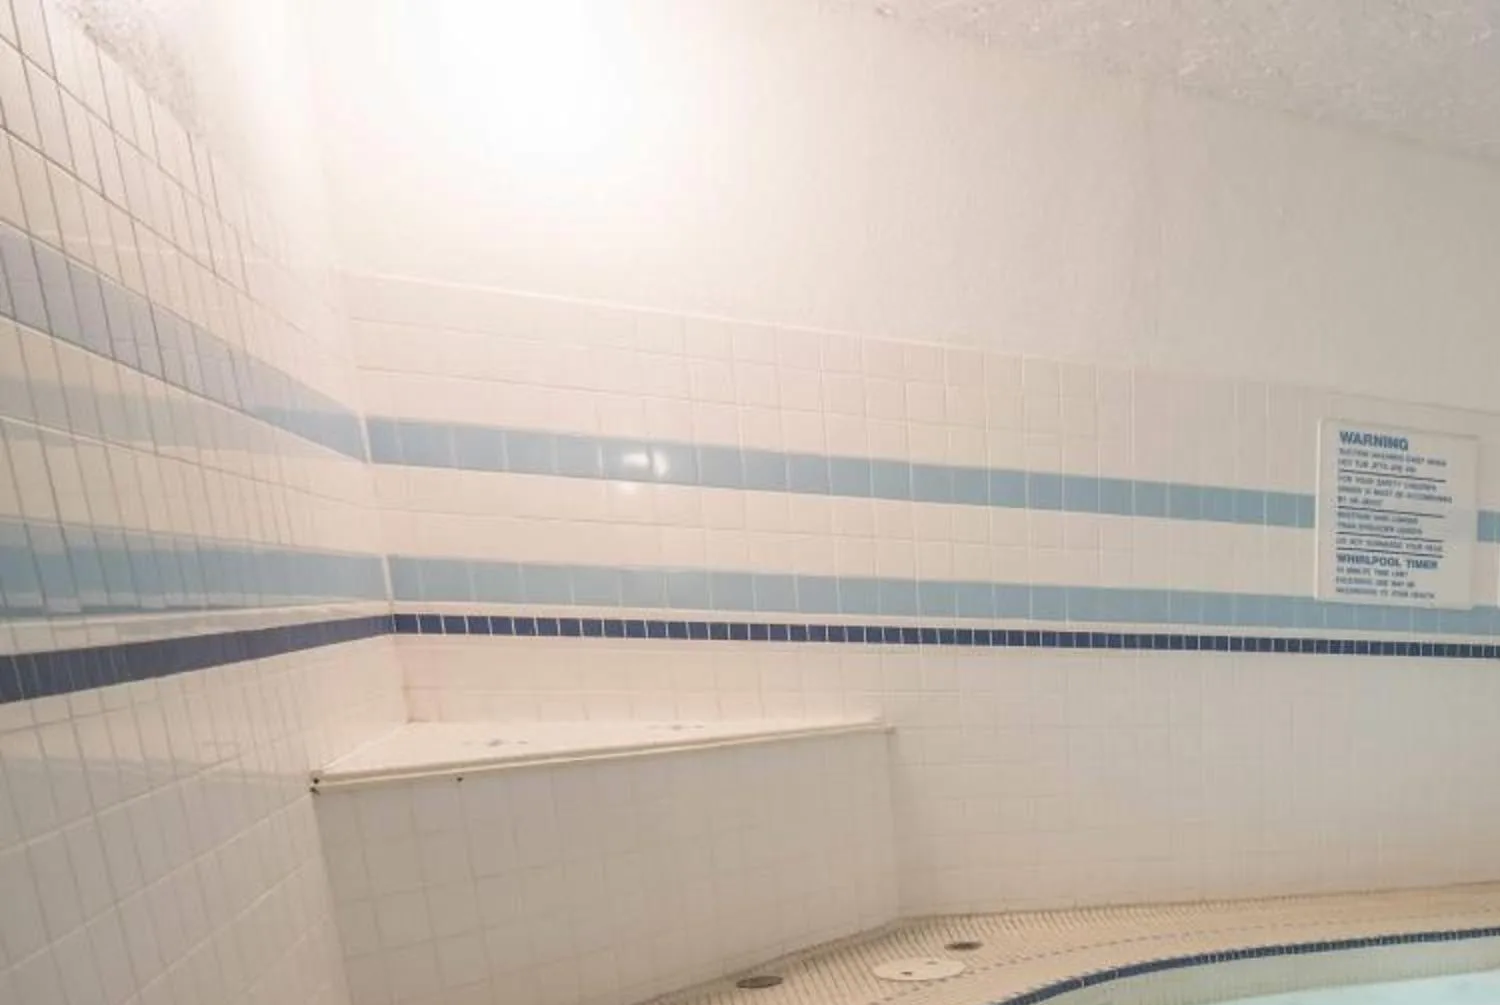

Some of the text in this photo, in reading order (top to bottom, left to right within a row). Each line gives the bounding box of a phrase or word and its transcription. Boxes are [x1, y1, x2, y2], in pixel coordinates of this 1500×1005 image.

[1339, 431, 1408, 450] WARNING
[1336, 554, 1438, 570] WHIRLPOOL TIMER
